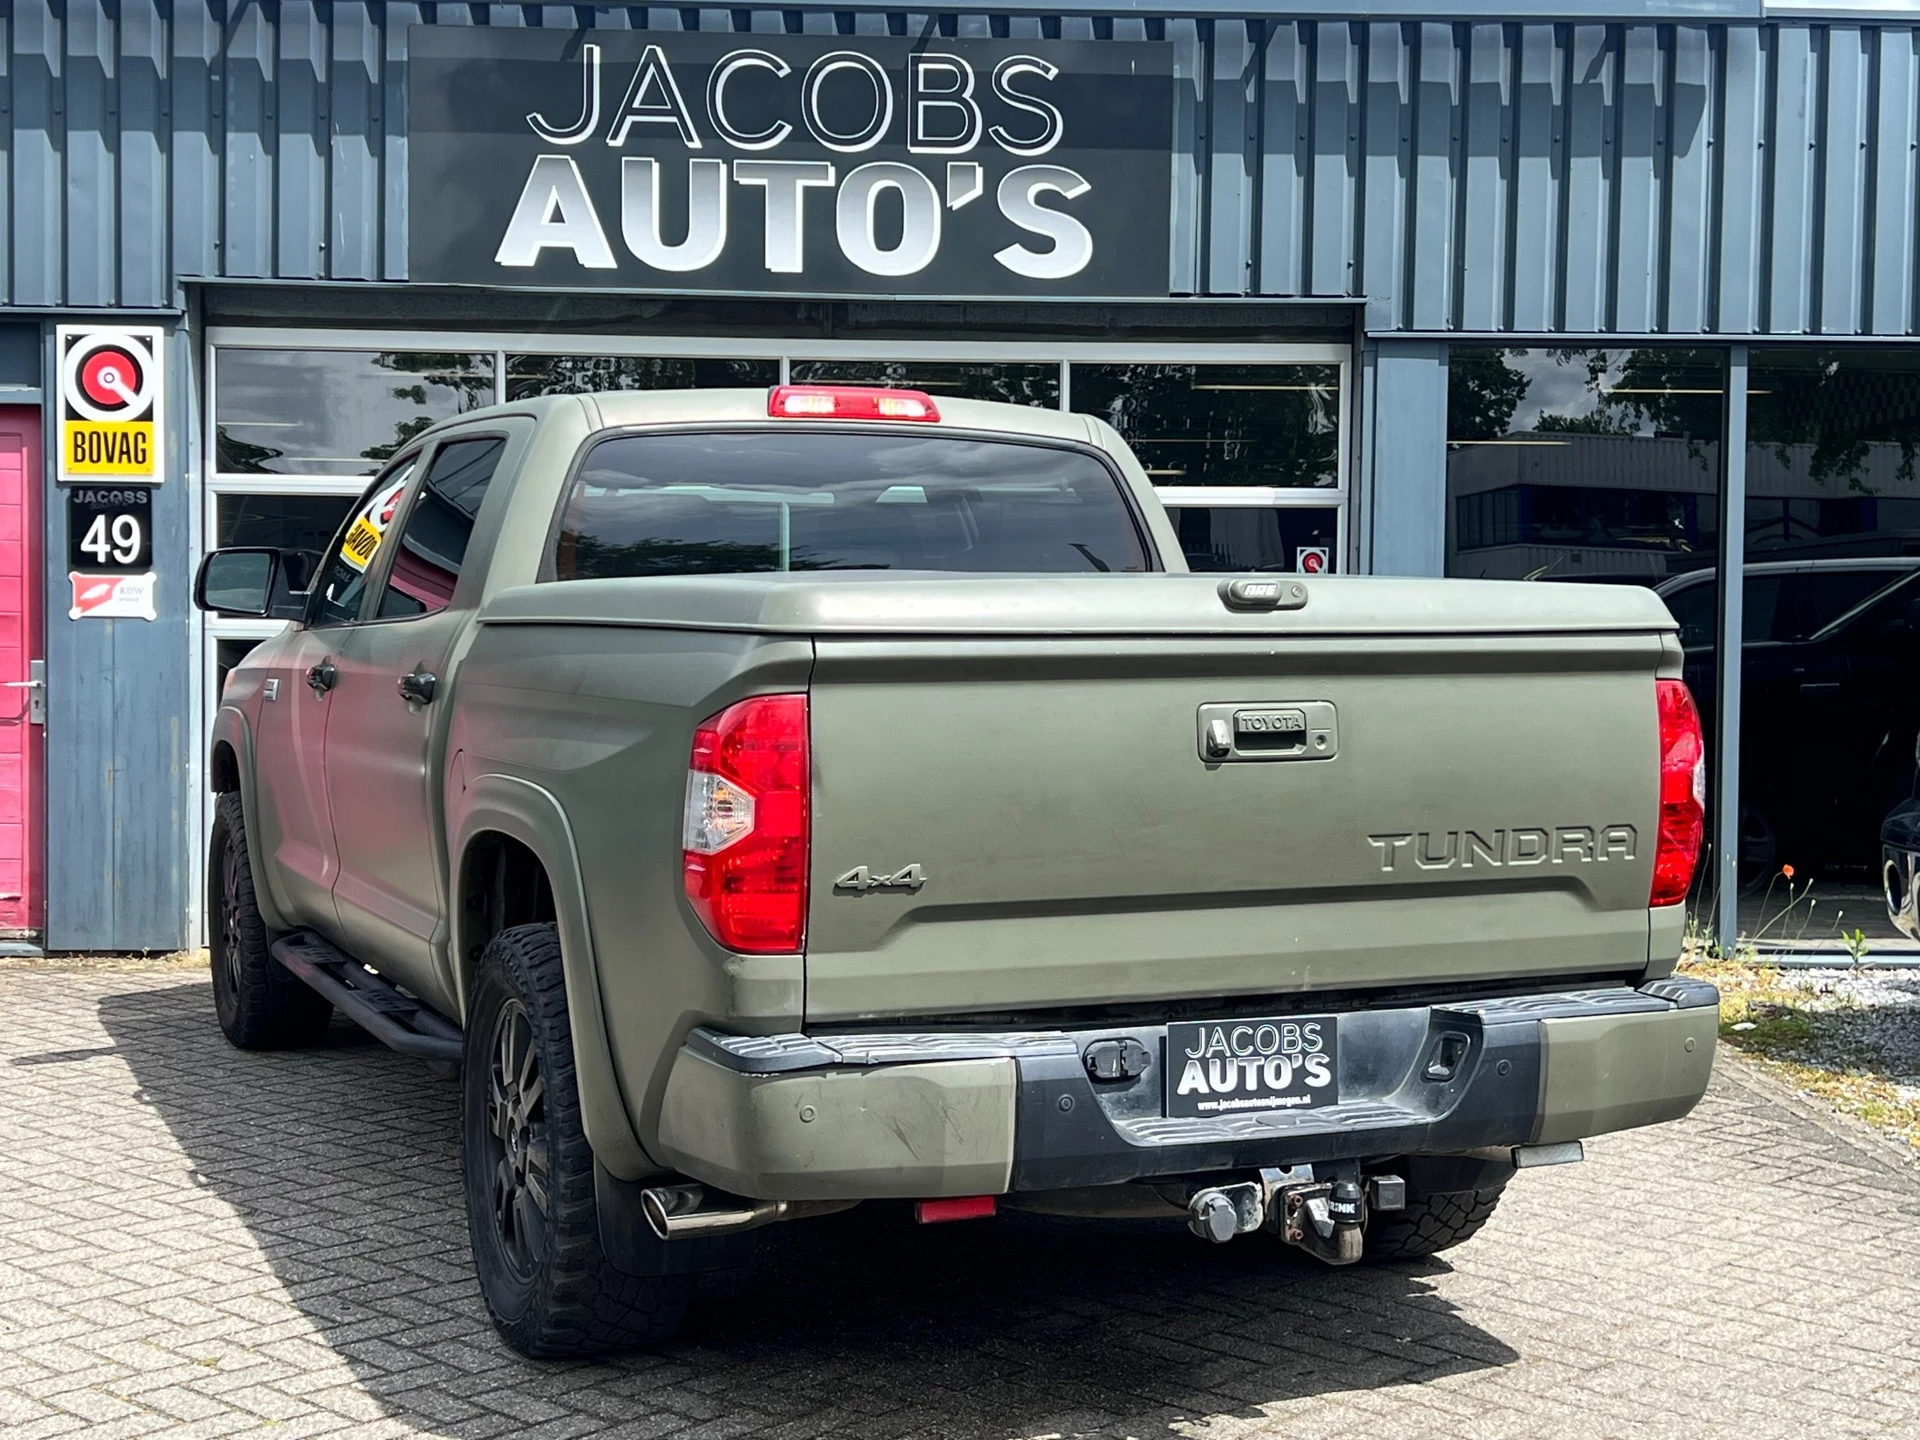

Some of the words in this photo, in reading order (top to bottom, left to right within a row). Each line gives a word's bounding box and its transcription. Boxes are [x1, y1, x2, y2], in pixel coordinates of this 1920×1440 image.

[525, 44, 1064, 156] JACOBS
[494, 154, 1094, 279] AUTO'S
[73, 431, 147, 464] BOVAG
[73, 490, 148, 504] JACOBS
[80, 514, 141, 564] 49
[1241, 715, 1303, 731] TOYOTA
[1367, 823, 1638, 873] TUNDRA
[1184, 1022, 1323, 1058] JACOBS
[1176, 1053, 1331, 1095] AUTO'S
[1329, 1201, 1356, 1214] RINK
